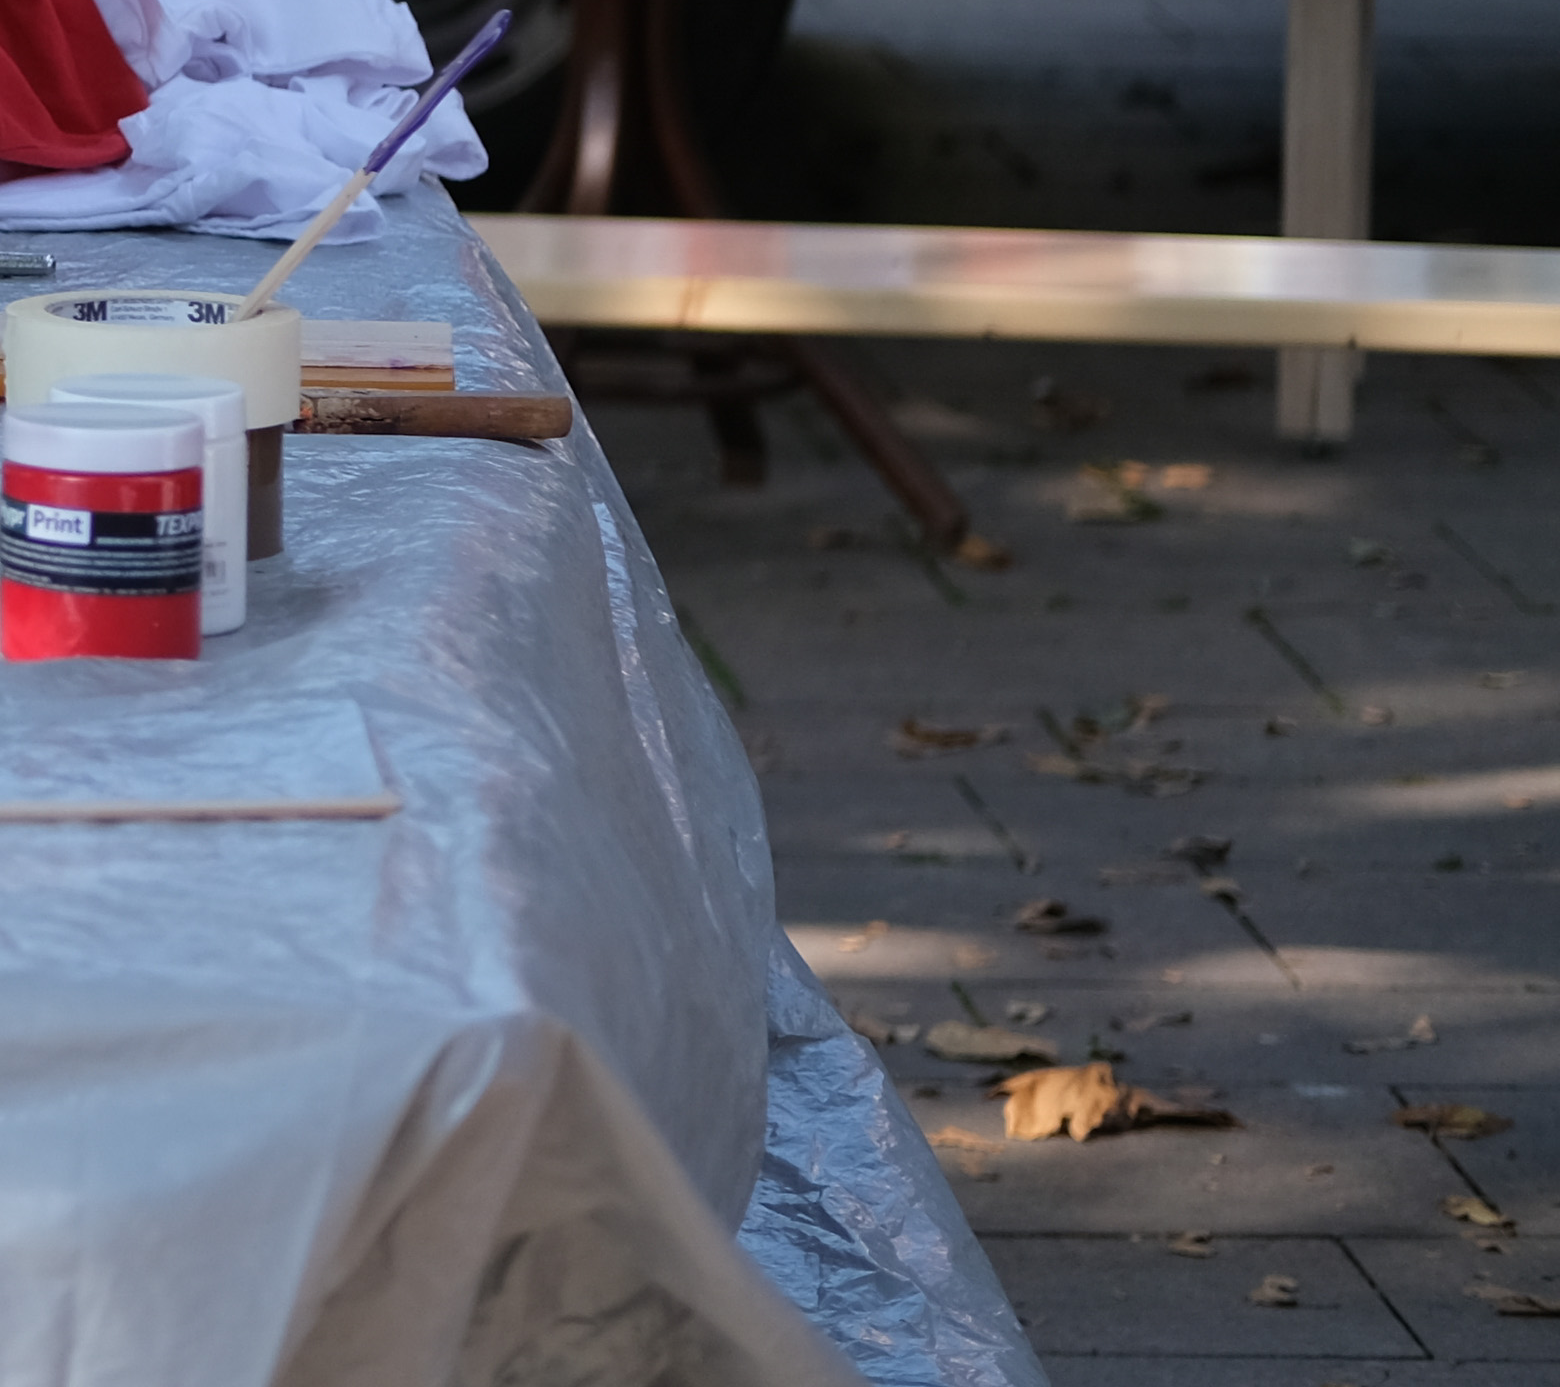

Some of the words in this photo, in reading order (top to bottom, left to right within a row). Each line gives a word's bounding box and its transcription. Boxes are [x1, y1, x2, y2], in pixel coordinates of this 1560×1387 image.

[73, 300, 107, 322] 3M
[187, 300, 226, 325] 3M
[33, 508, 85, 535] Print
